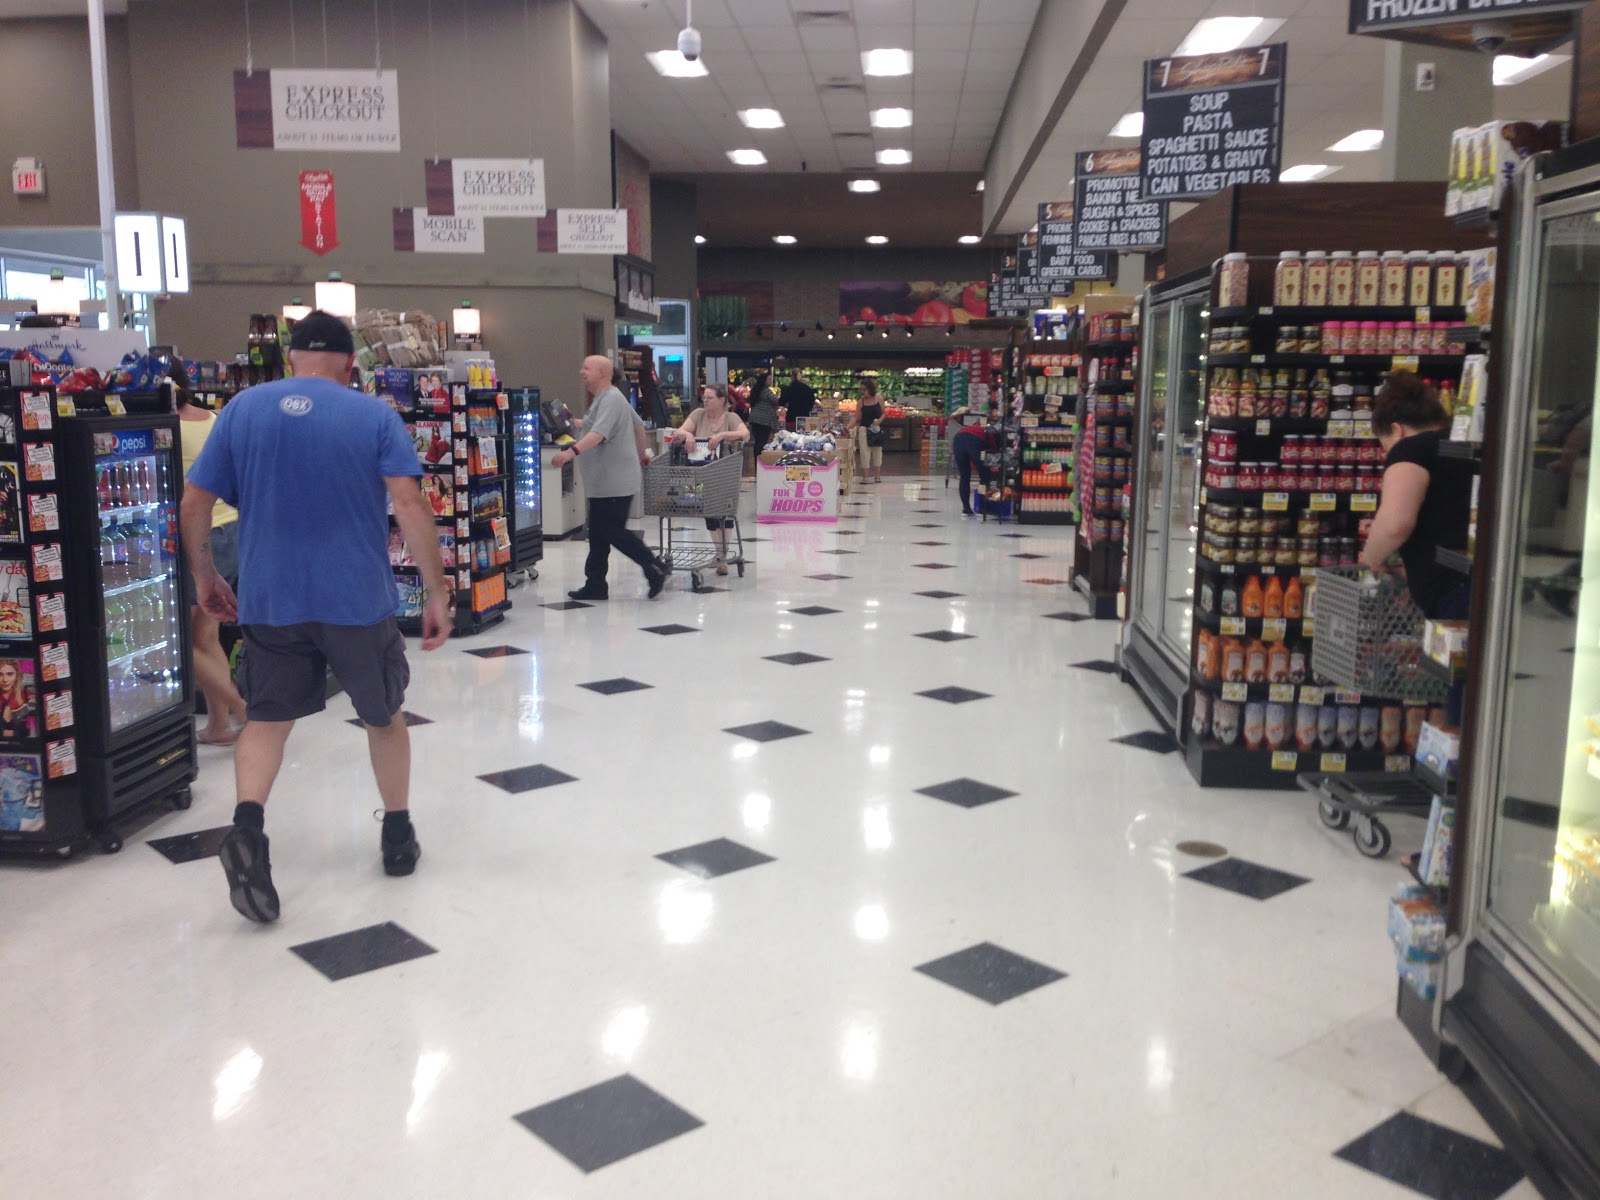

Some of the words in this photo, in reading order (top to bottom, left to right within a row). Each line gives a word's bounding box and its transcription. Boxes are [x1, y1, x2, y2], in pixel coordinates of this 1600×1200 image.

[1258, 47, 1270, 76] 7
[1160, 60, 1172, 88] 7
[286, 85, 385, 104] EXPRESS
[1189, 91, 1229, 113] SOUP
[285, 102, 385, 121] CHECKOUT
[1183, 111, 1233, 133] PASTA
[1148, 133, 1220, 156] SPAGHETTI
[1224, 128, 1269, 149] SAUCE
[1085, 153, 1094, 172] 6
[1147, 154, 1208, 176] POTATOES
[1211, 155, 1221, 170] &
[1223, 148, 1267, 170] GRAVY
[18, 172, 37, 190] EXIT
[463, 170, 536, 184] EXPRESS
[1151, 176, 1179, 195] CAN
[1185, 168, 1271, 192] VEGETABLES
[463, 184, 536, 196] CHECKOUT
[1085, 191, 1122, 206] BAKING
[568, 213, 617, 224] EXPRESS
[1046, 204, 1052, 219] 5
[1082, 205, 1115, 219] SUGAR
[1116, 206, 1124, 217] &
[1125, 203, 1159, 217] SPICES
[423, 218, 476, 230] MOBILE
[579, 224, 605, 233] SELF
[1078, 220, 1110, 233] COOKIES
[1111, 221, 1118, 232] &
[1120, 217, 1160, 231] CRACKERS
[430, 231, 468, 242] SCAN
[1078, 234, 1107, 247] PANCAKE
[1109, 233, 1129, 246] MIXES
[1130, 233, 1137, 244] &
[1137, 231, 1160, 244] SYRUP
[1050, 256, 1071, 266] BABY
[1073, 255, 1095, 265] FOOD
[1041, 266, 1075, 277] GREETING
[1077, 265, 1103, 275] CARDS
[1024, 285, 1048, 293] HEALTH
[1051, 284, 1066, 292] AIDS
[28, 338, 87, 351] Hallmark
[121, 435, 146, 453] pepsi
[773, 489, 790, 497] FUN
[771, 499, 824, 513] HOOPS
